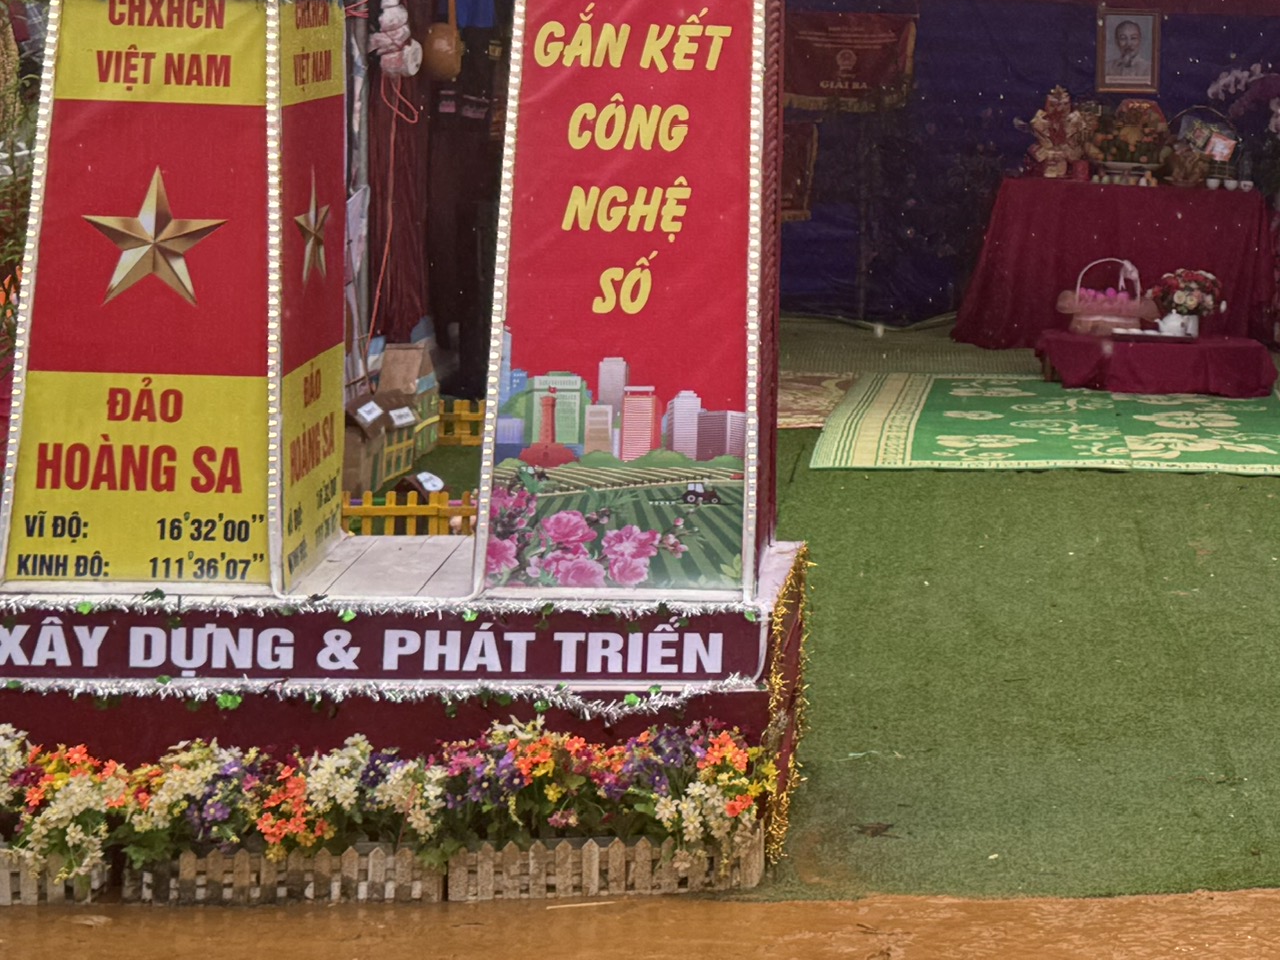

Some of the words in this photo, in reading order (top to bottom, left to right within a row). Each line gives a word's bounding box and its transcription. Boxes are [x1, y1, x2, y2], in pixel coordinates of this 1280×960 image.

[96, 44, 156, 91] VIỆT
[164, 53, 231, 87] NAM
[533, 3, 631, 68] GẮN
[639, 8, 731, 73] KẾT
[568, 93, 689, 152] CÔNG
[562, 176, 691, 243] NGHỆ
[592, 251, 658, 314] SỐ
[107, 377, 183, 423] ĐẢO
[36, 434, 177, 492] HOÀNG
[190, 446, 243, 494] SA
[25, 511, 46, 538] VĨ
[52, 511, 90, 543] ĐỘ:
[17, 554, 69, 578] KINH
[0, 617, 109, 667] XÂY
[129, 623, 294, 677] DỰNG
[316, 628, 361, 670] &
[383, 623, 535, 673] PHÁT
[553, 616, 723, 674] TRIỂN
